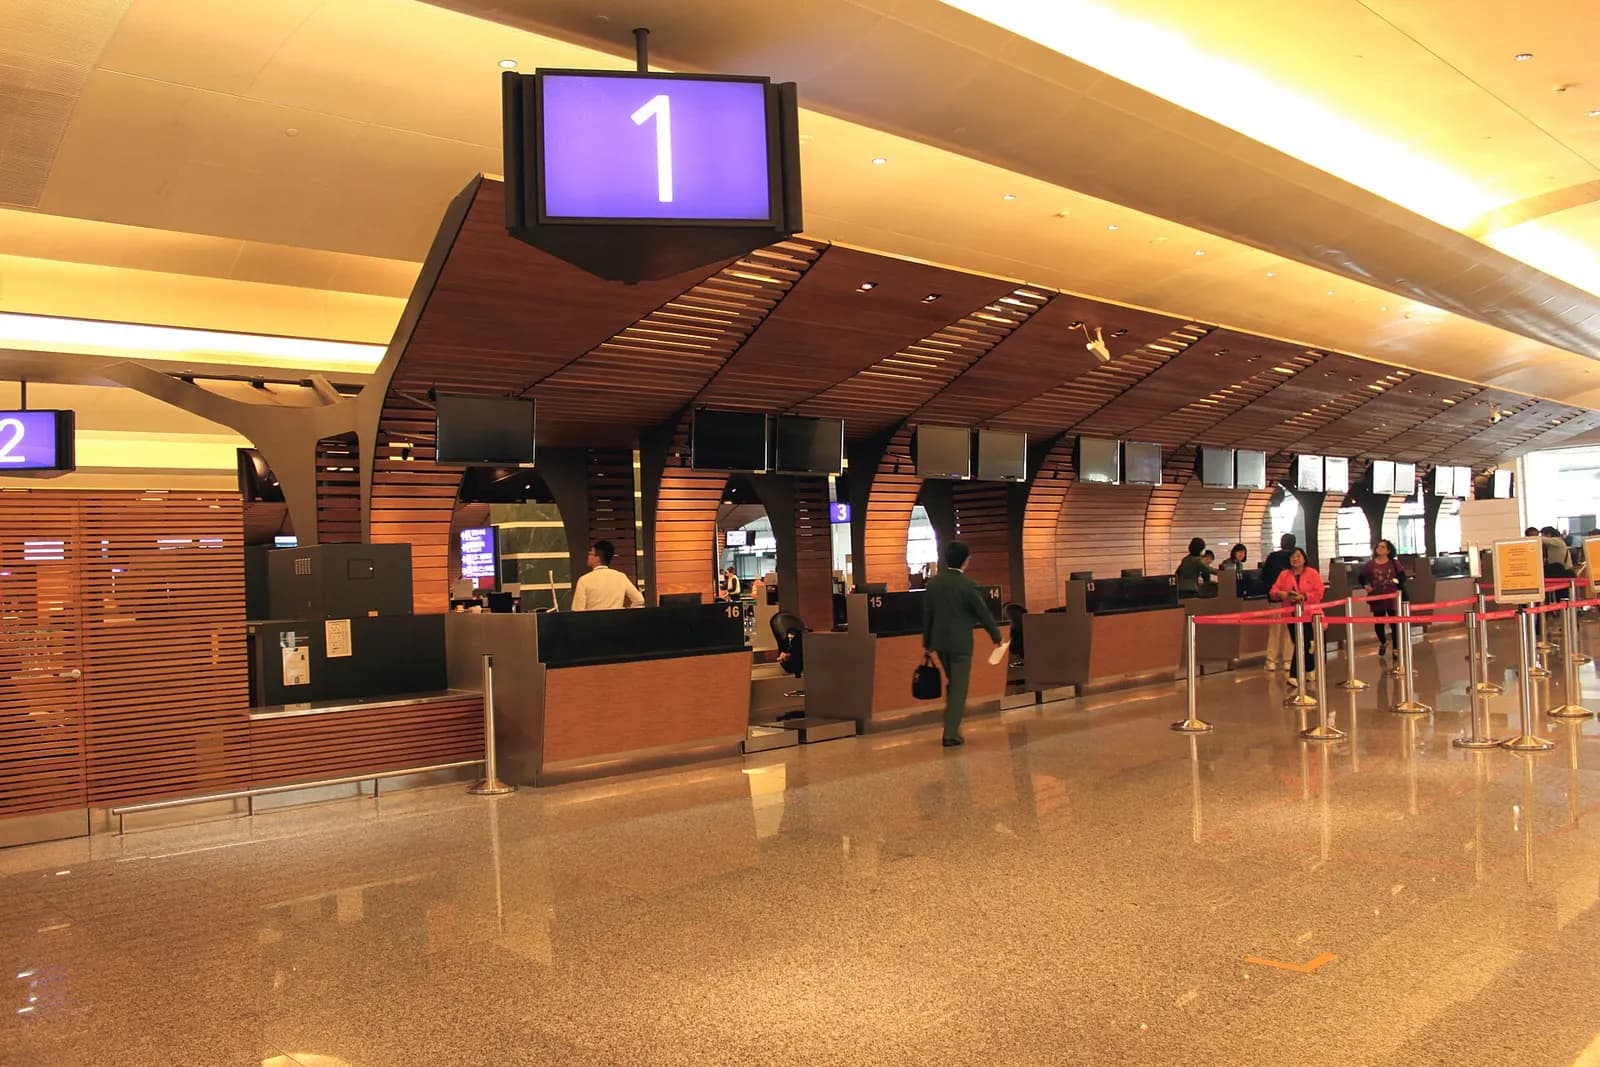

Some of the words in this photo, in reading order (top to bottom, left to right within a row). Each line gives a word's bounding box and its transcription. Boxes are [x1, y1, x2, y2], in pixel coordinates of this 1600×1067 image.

[630, 94, 673, 203] 1
[0, 418, 26, 463] 2
[837, 503, 847, 521] 3
[989, 588, 999, 599] 14
[1087, 582, 1095, 593] 13
[870, 596, 882, 608] 15
[725, 606, 740, 618] 16
